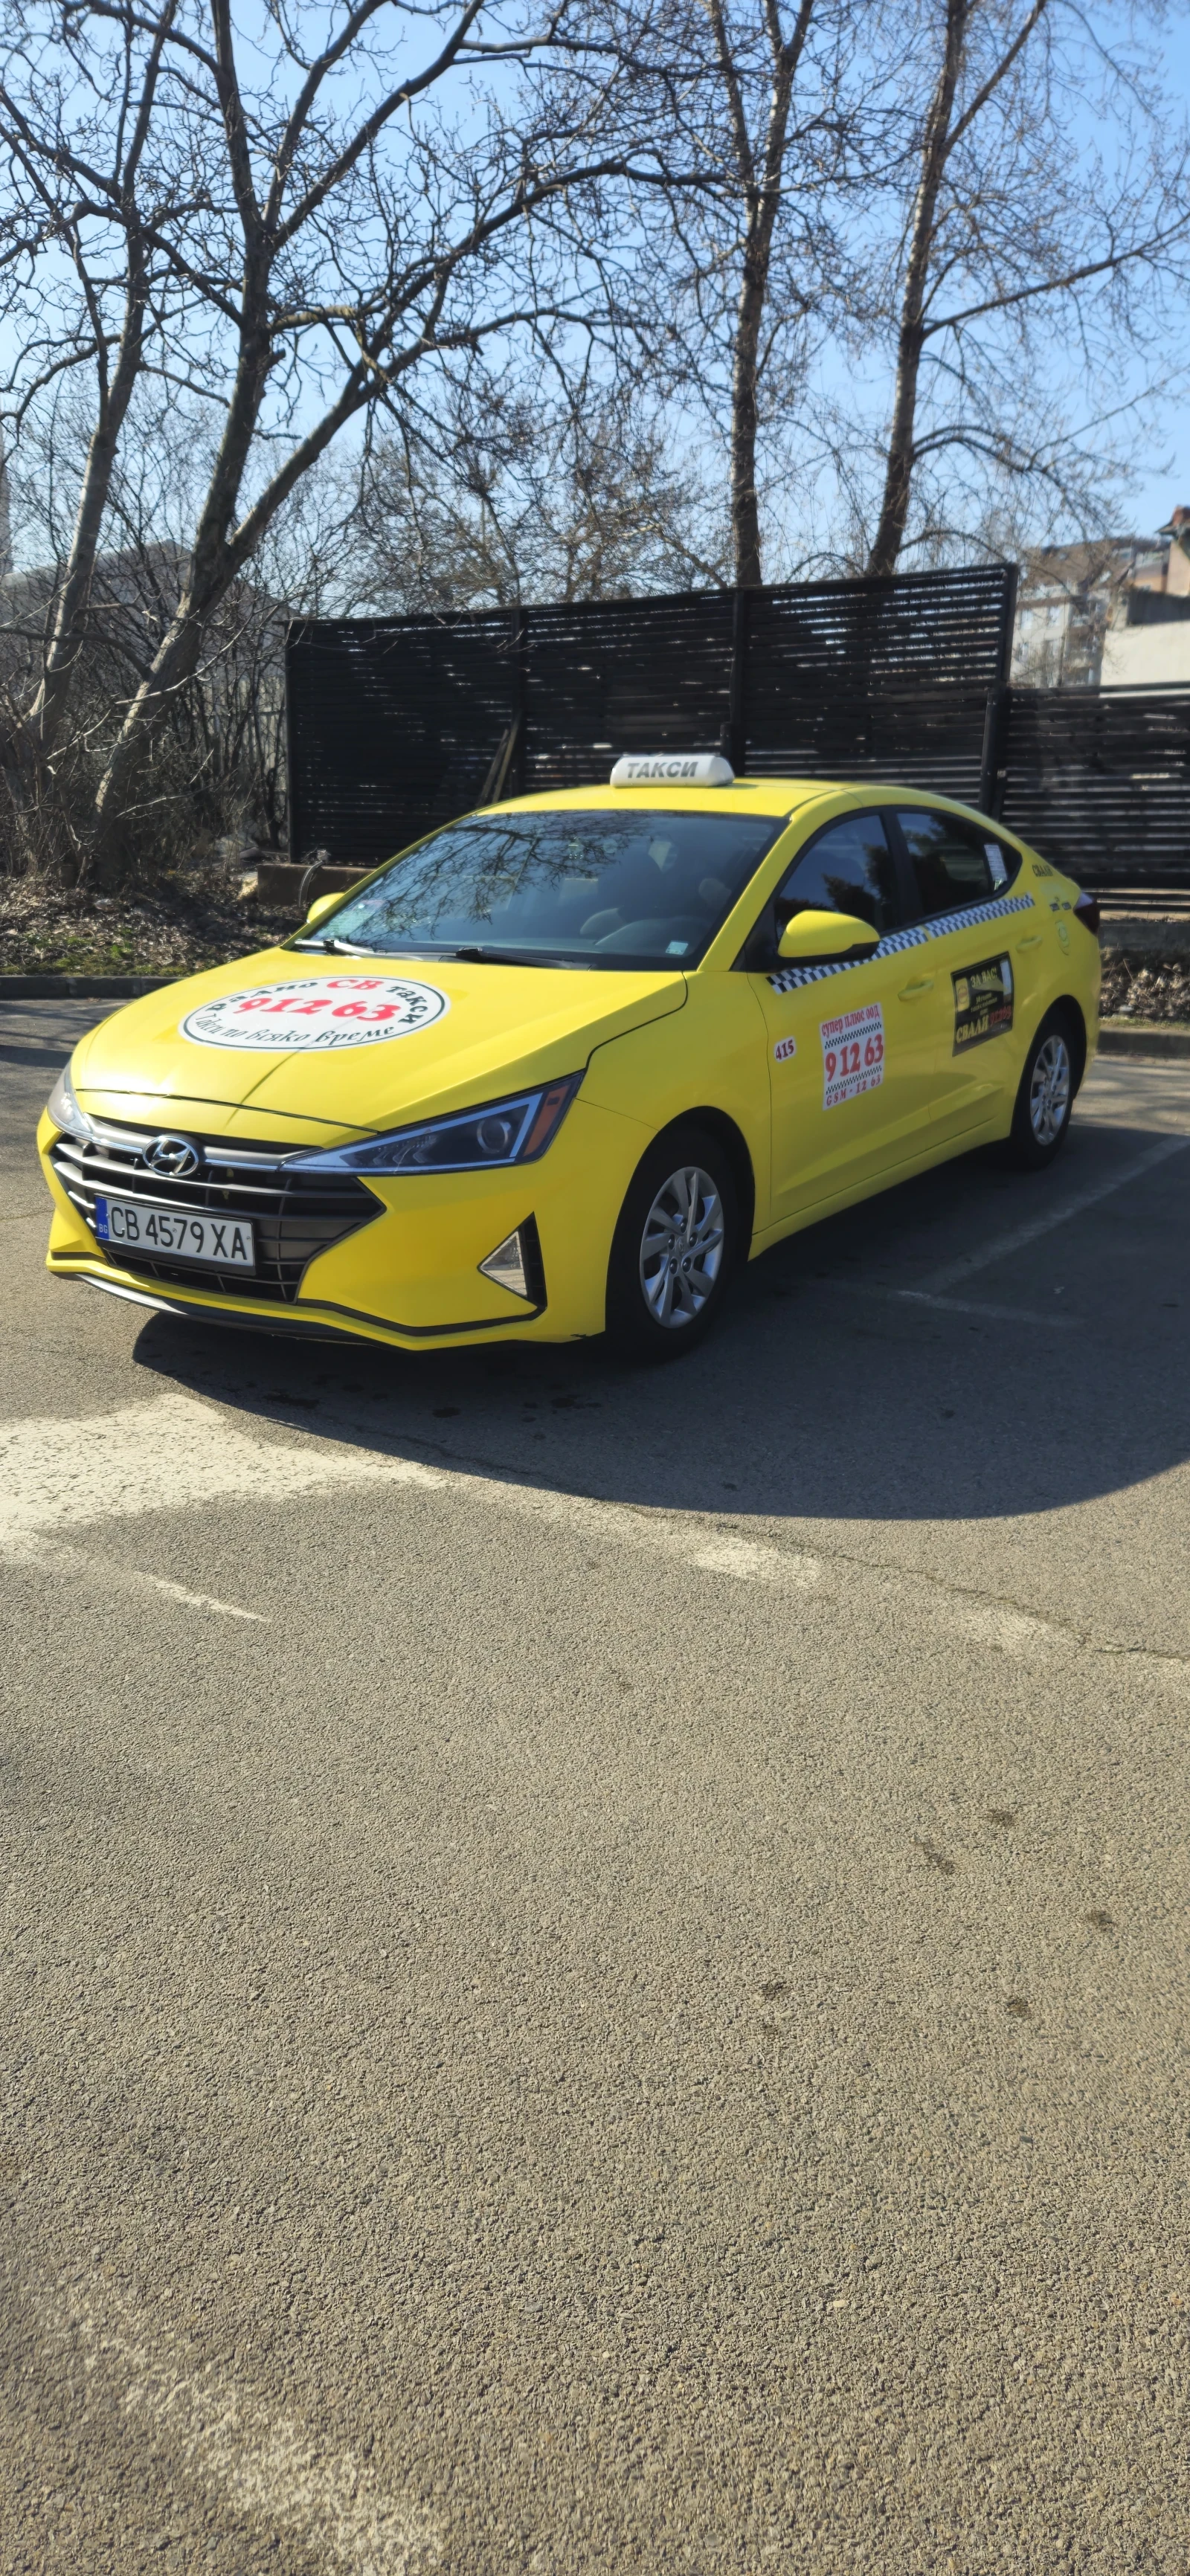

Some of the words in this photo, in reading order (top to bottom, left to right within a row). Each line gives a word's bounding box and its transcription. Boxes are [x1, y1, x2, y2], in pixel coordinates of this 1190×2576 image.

[627, 761, 699, 779] ТАКСИ
[385, 986, 428, 1025] такси
[821, 1018, 843, 1037] супер
[845, 1009, 865, 1028] плюс
[315, 1026, 395, 1046] време
[775, 1040, 794, 1060] 415
[98, 1223, 109, 1234] BG
[145, 1214, 205, 1254] 4579
